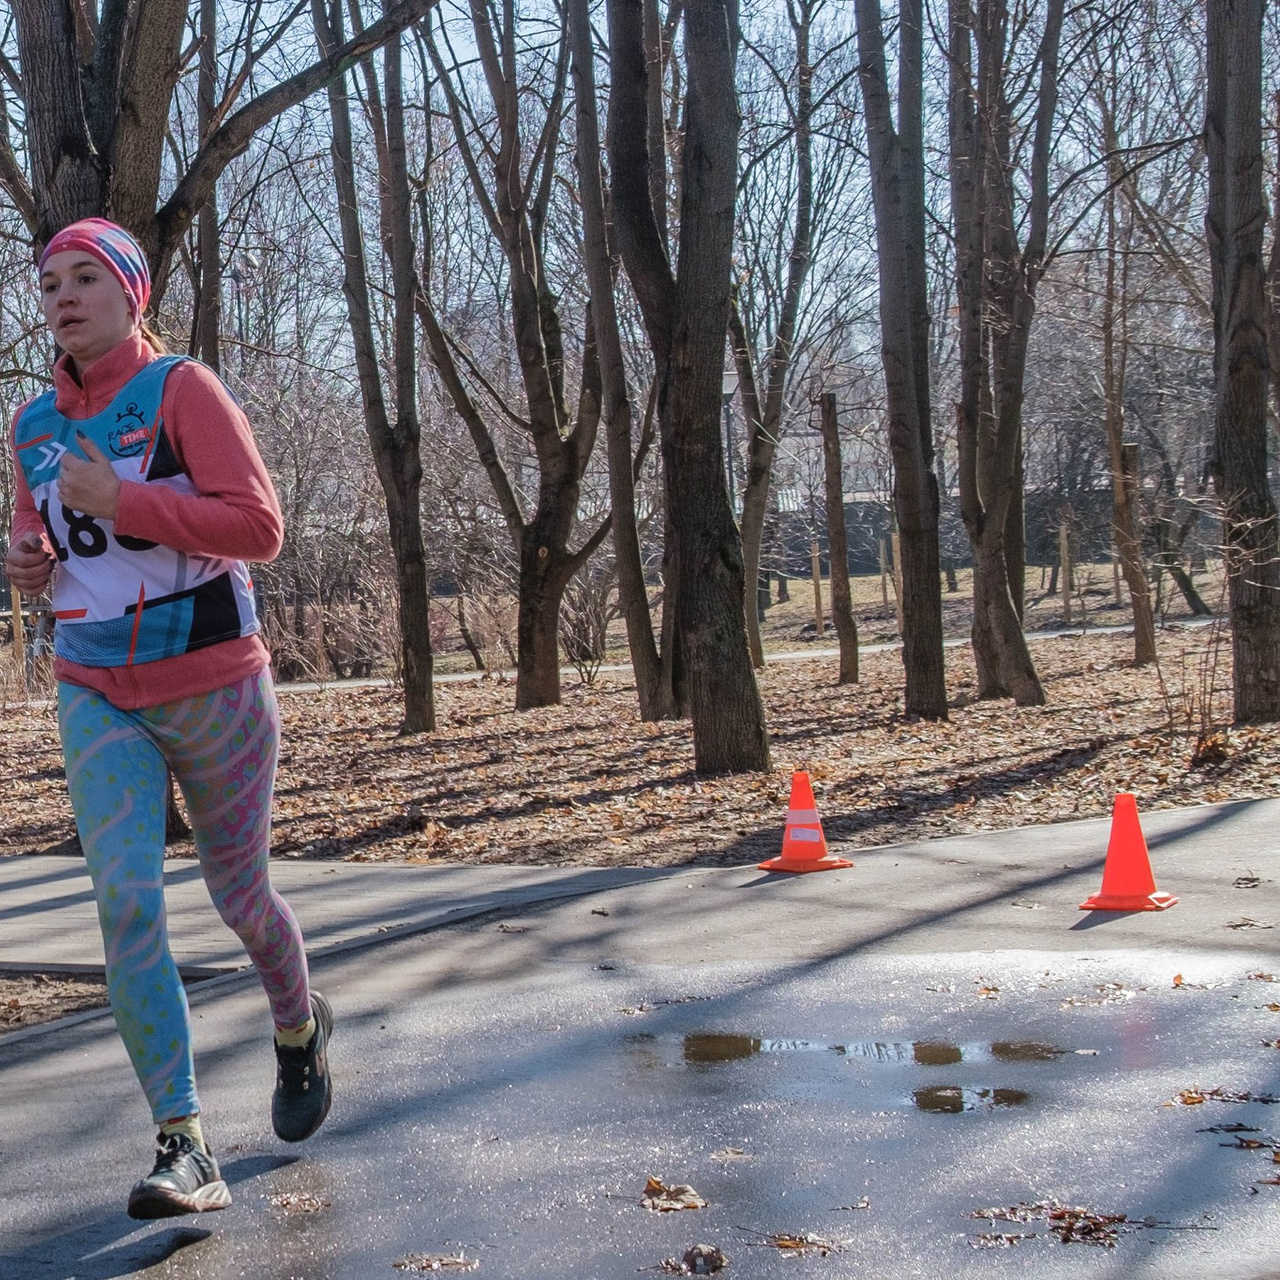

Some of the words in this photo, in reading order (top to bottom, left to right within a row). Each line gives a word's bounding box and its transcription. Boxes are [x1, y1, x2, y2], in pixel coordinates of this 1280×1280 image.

[107, 422, 136, 441] RACE
[122, 429, 146, 444] TIME
[39, 498, 160, 562] 18
